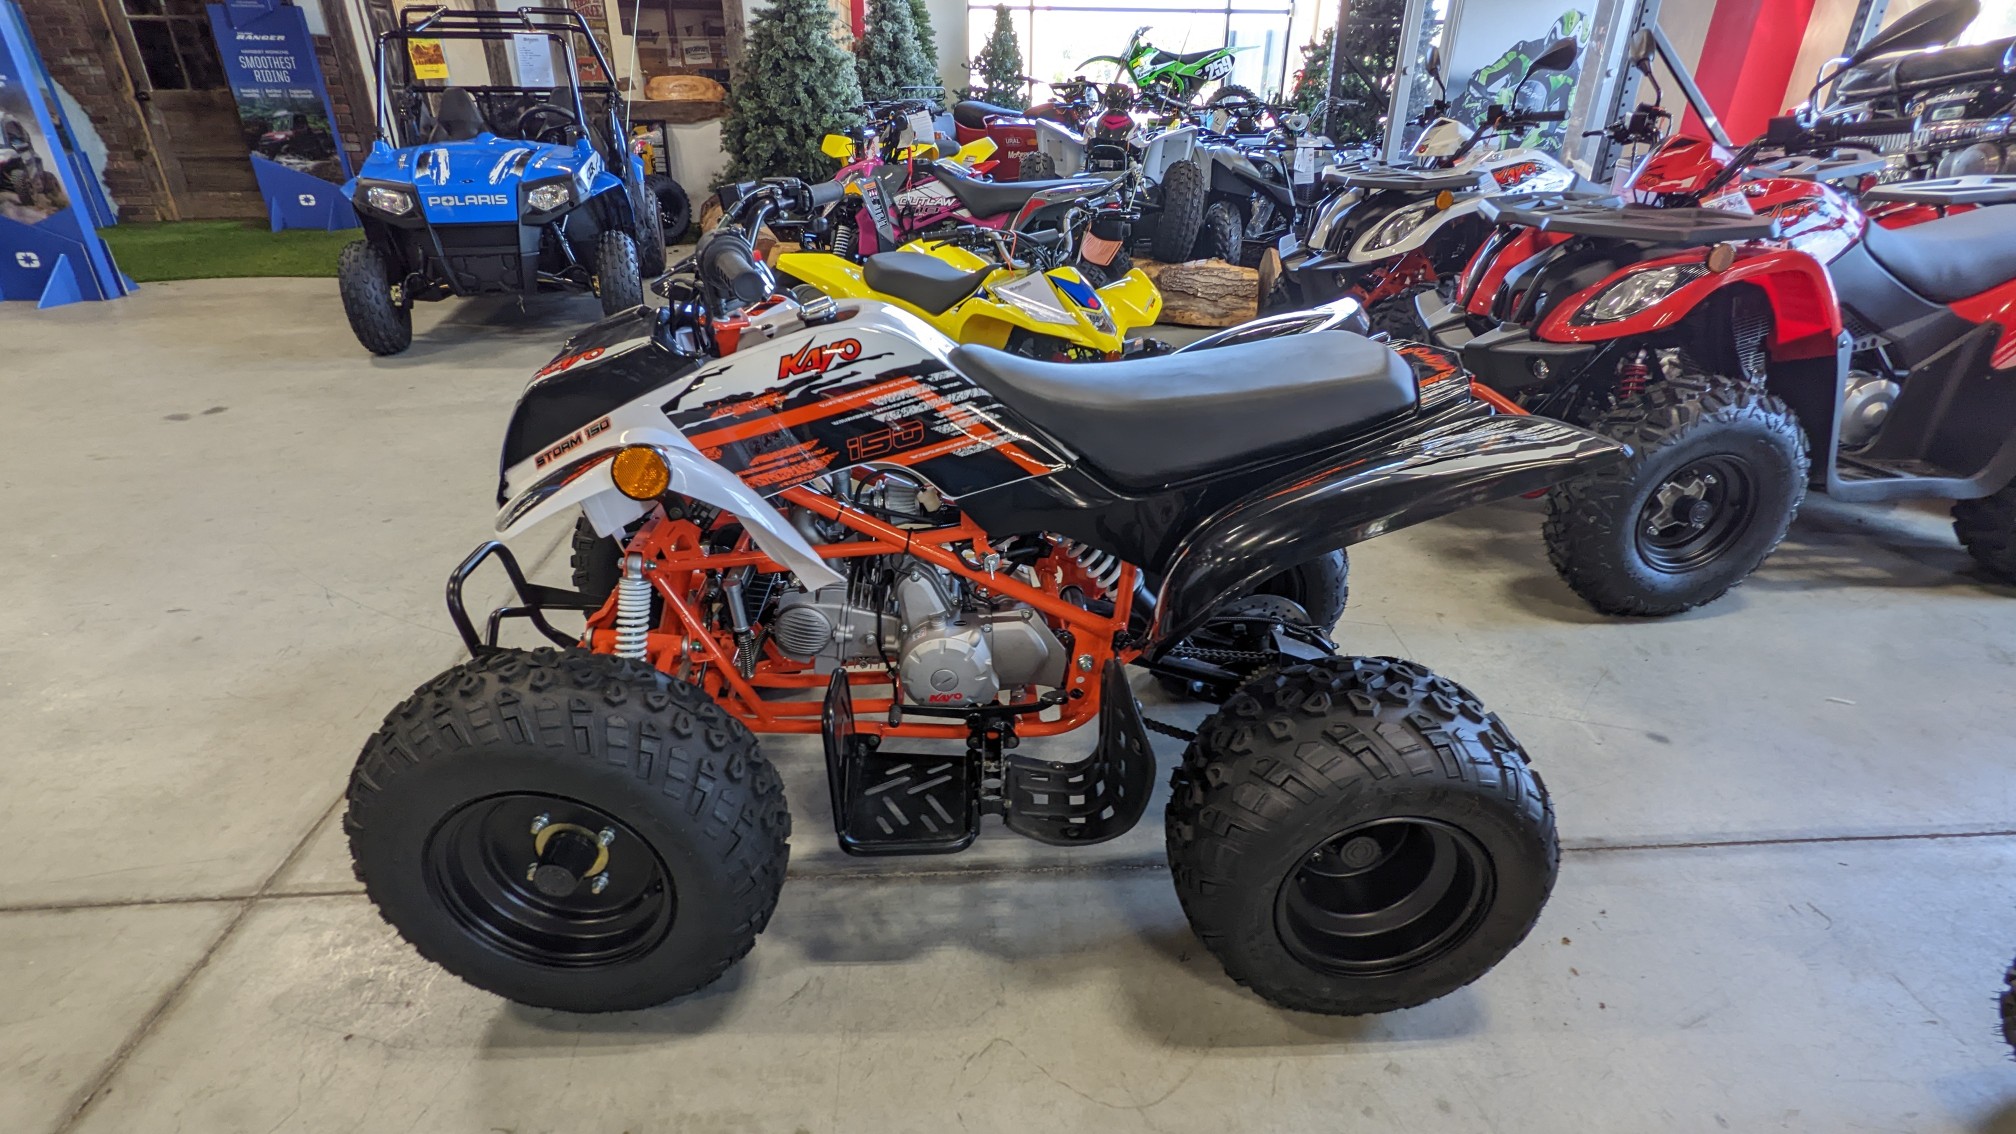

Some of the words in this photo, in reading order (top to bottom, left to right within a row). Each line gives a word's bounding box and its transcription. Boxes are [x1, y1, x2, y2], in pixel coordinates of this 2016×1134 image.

[239, 55, 296, 70] SMOOTHEST
[1205, 55, 1233, 81] 259
[253, 70, 291, 83] RIDING
[1493, 161, 1536, 184] KAYO
[428, 195, 508, 207] POLARIS
[899, 195, 957, 206] OUTLAW
[777, 335, 862, 380] KAYO
[534, 431, 583, 469] STORM
[585, 416, 611, 444] 150
[929, 692, 963, 704] KAYO
